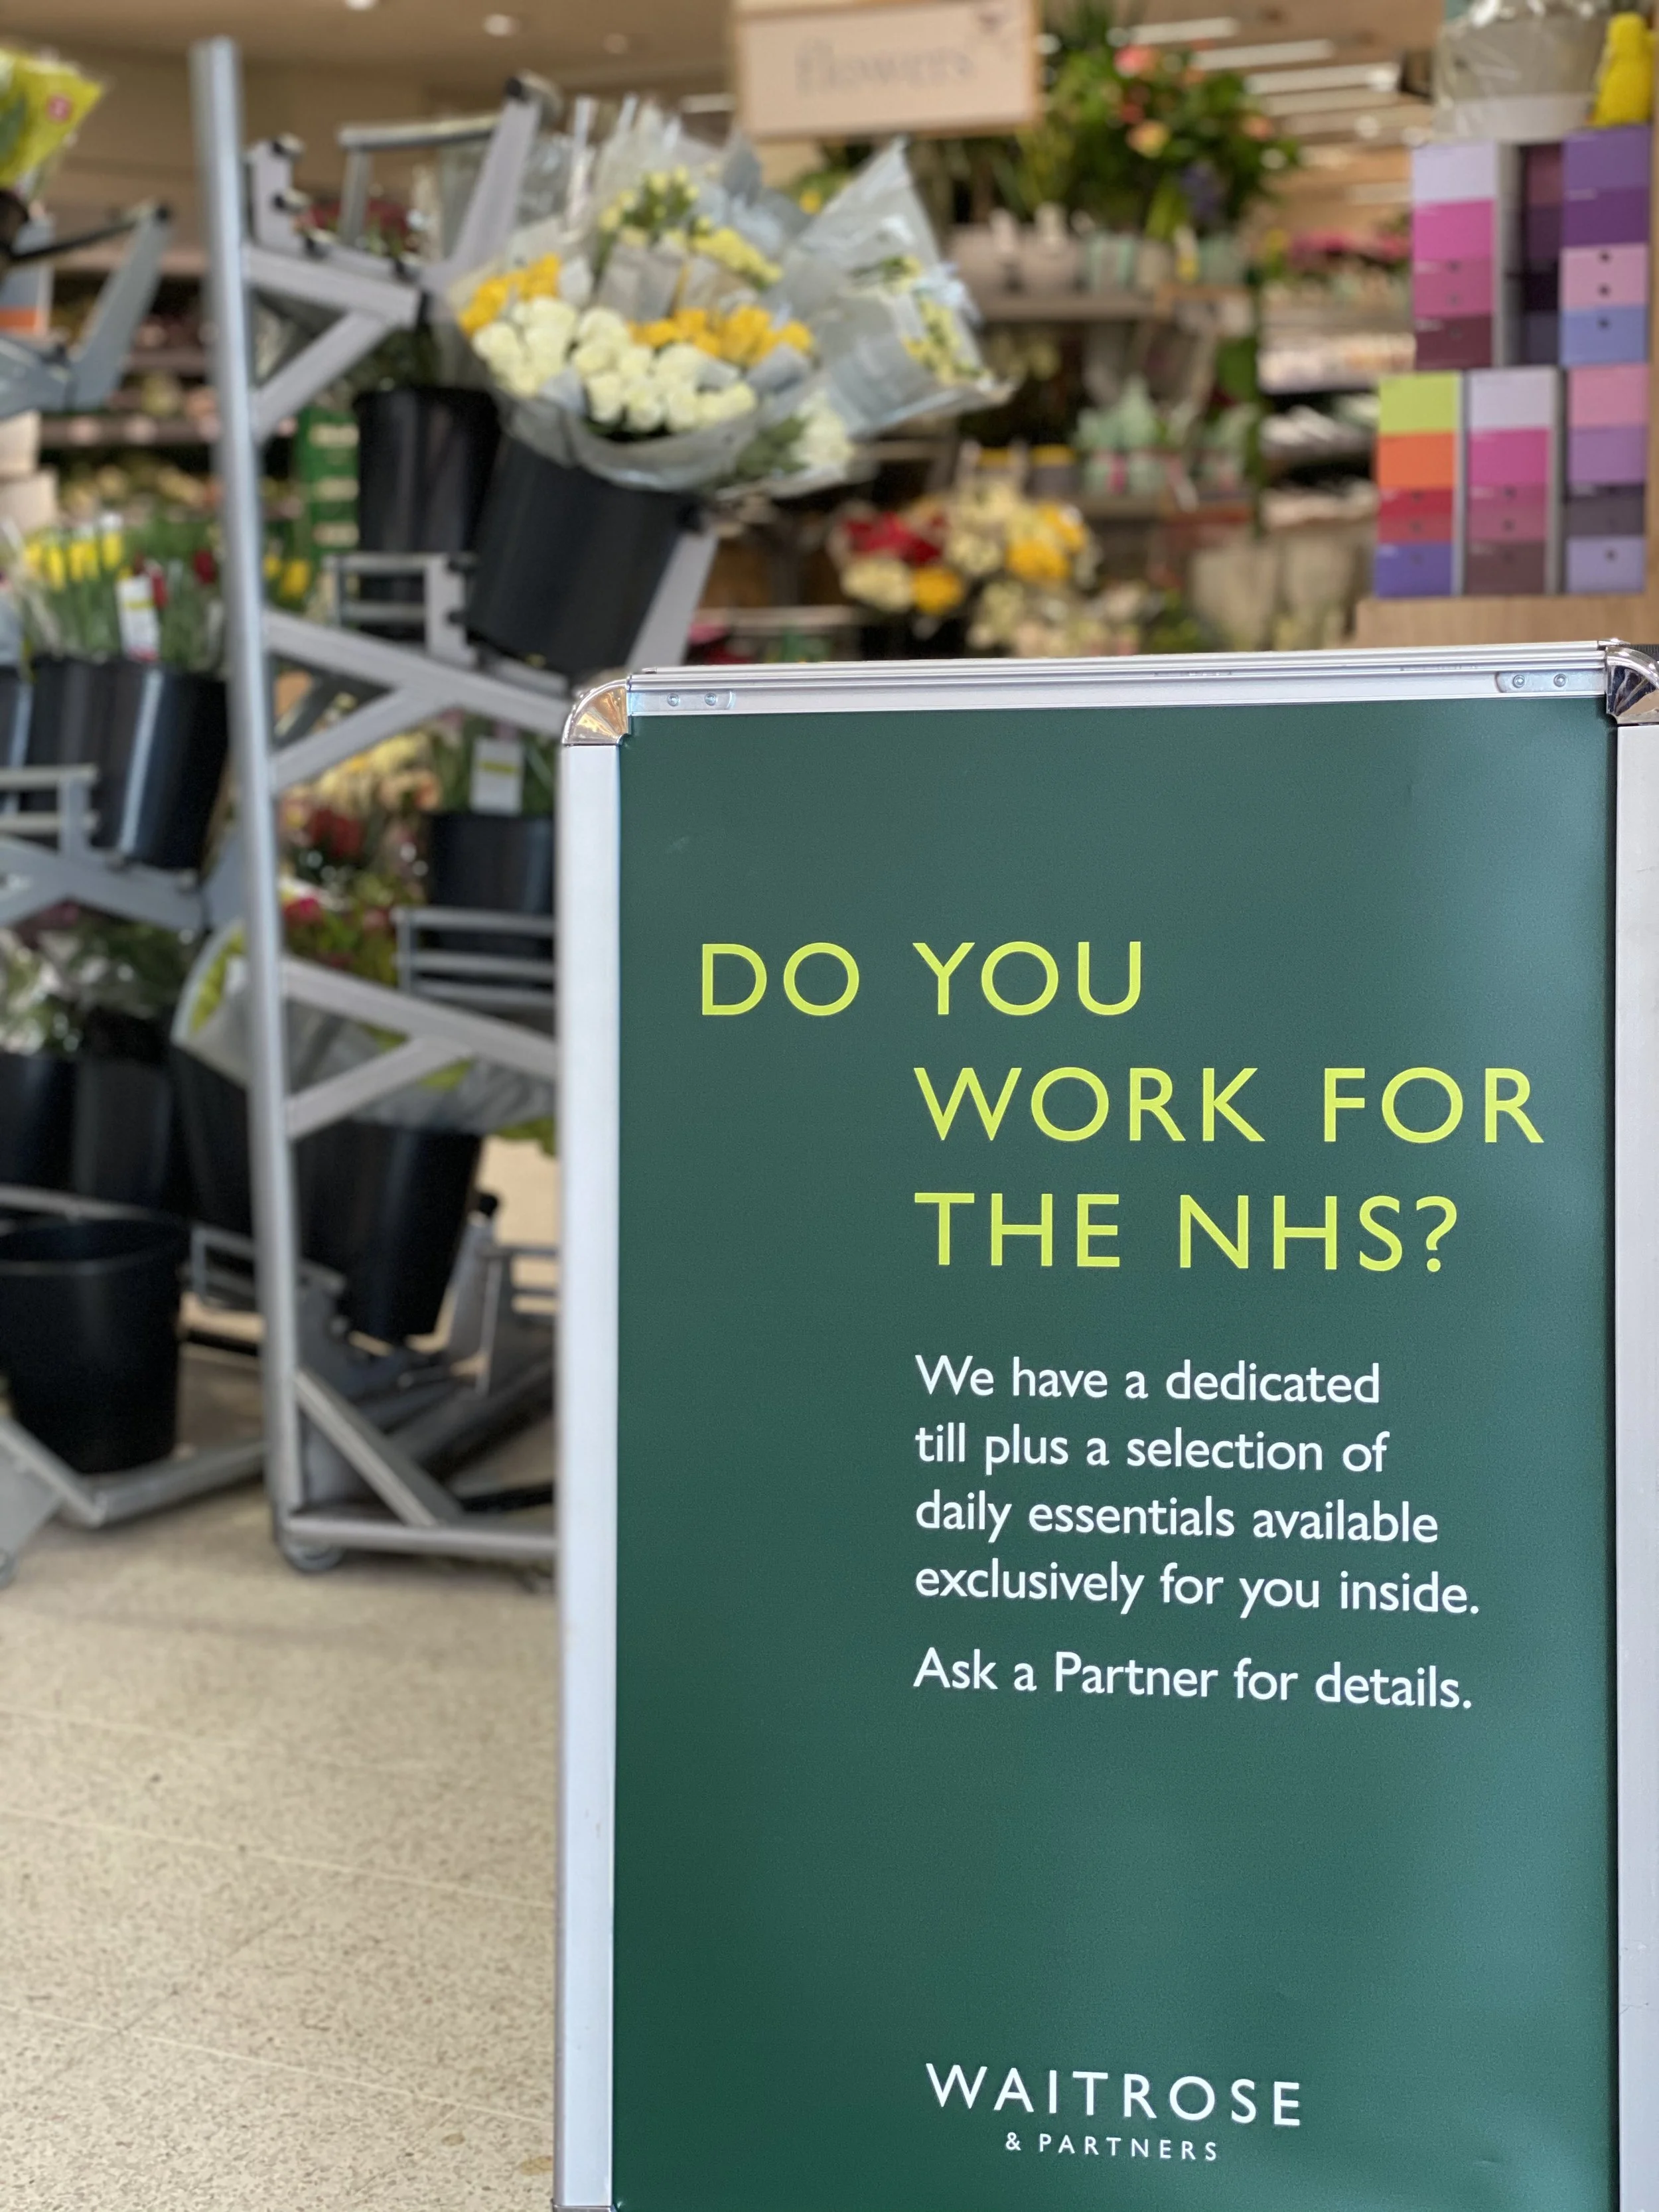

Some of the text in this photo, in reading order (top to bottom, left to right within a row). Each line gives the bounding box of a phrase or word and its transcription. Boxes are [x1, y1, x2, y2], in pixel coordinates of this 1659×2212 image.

[701, 940, 1142, 1017] DO YOU
[912, 1066, 1546, 1144] WORK FOR
[913, 1191, 1458, 1273] THE NHS?
[914, 1354, 1380, 1404] We have a dedicated
[914, 1421, 1391, 1477] till plus a selection of
[915, 1488, 1439, 1544] daily essentials available
[915, 1557, 1480, 1619] exclusively for you inside.
[912, 1646, 1473, 1710] Ask a Partner for details.
[925, 2062, 1301, 2127] WAITROSE
[1004, 2131, 1217, 2162] & PARTNERS
